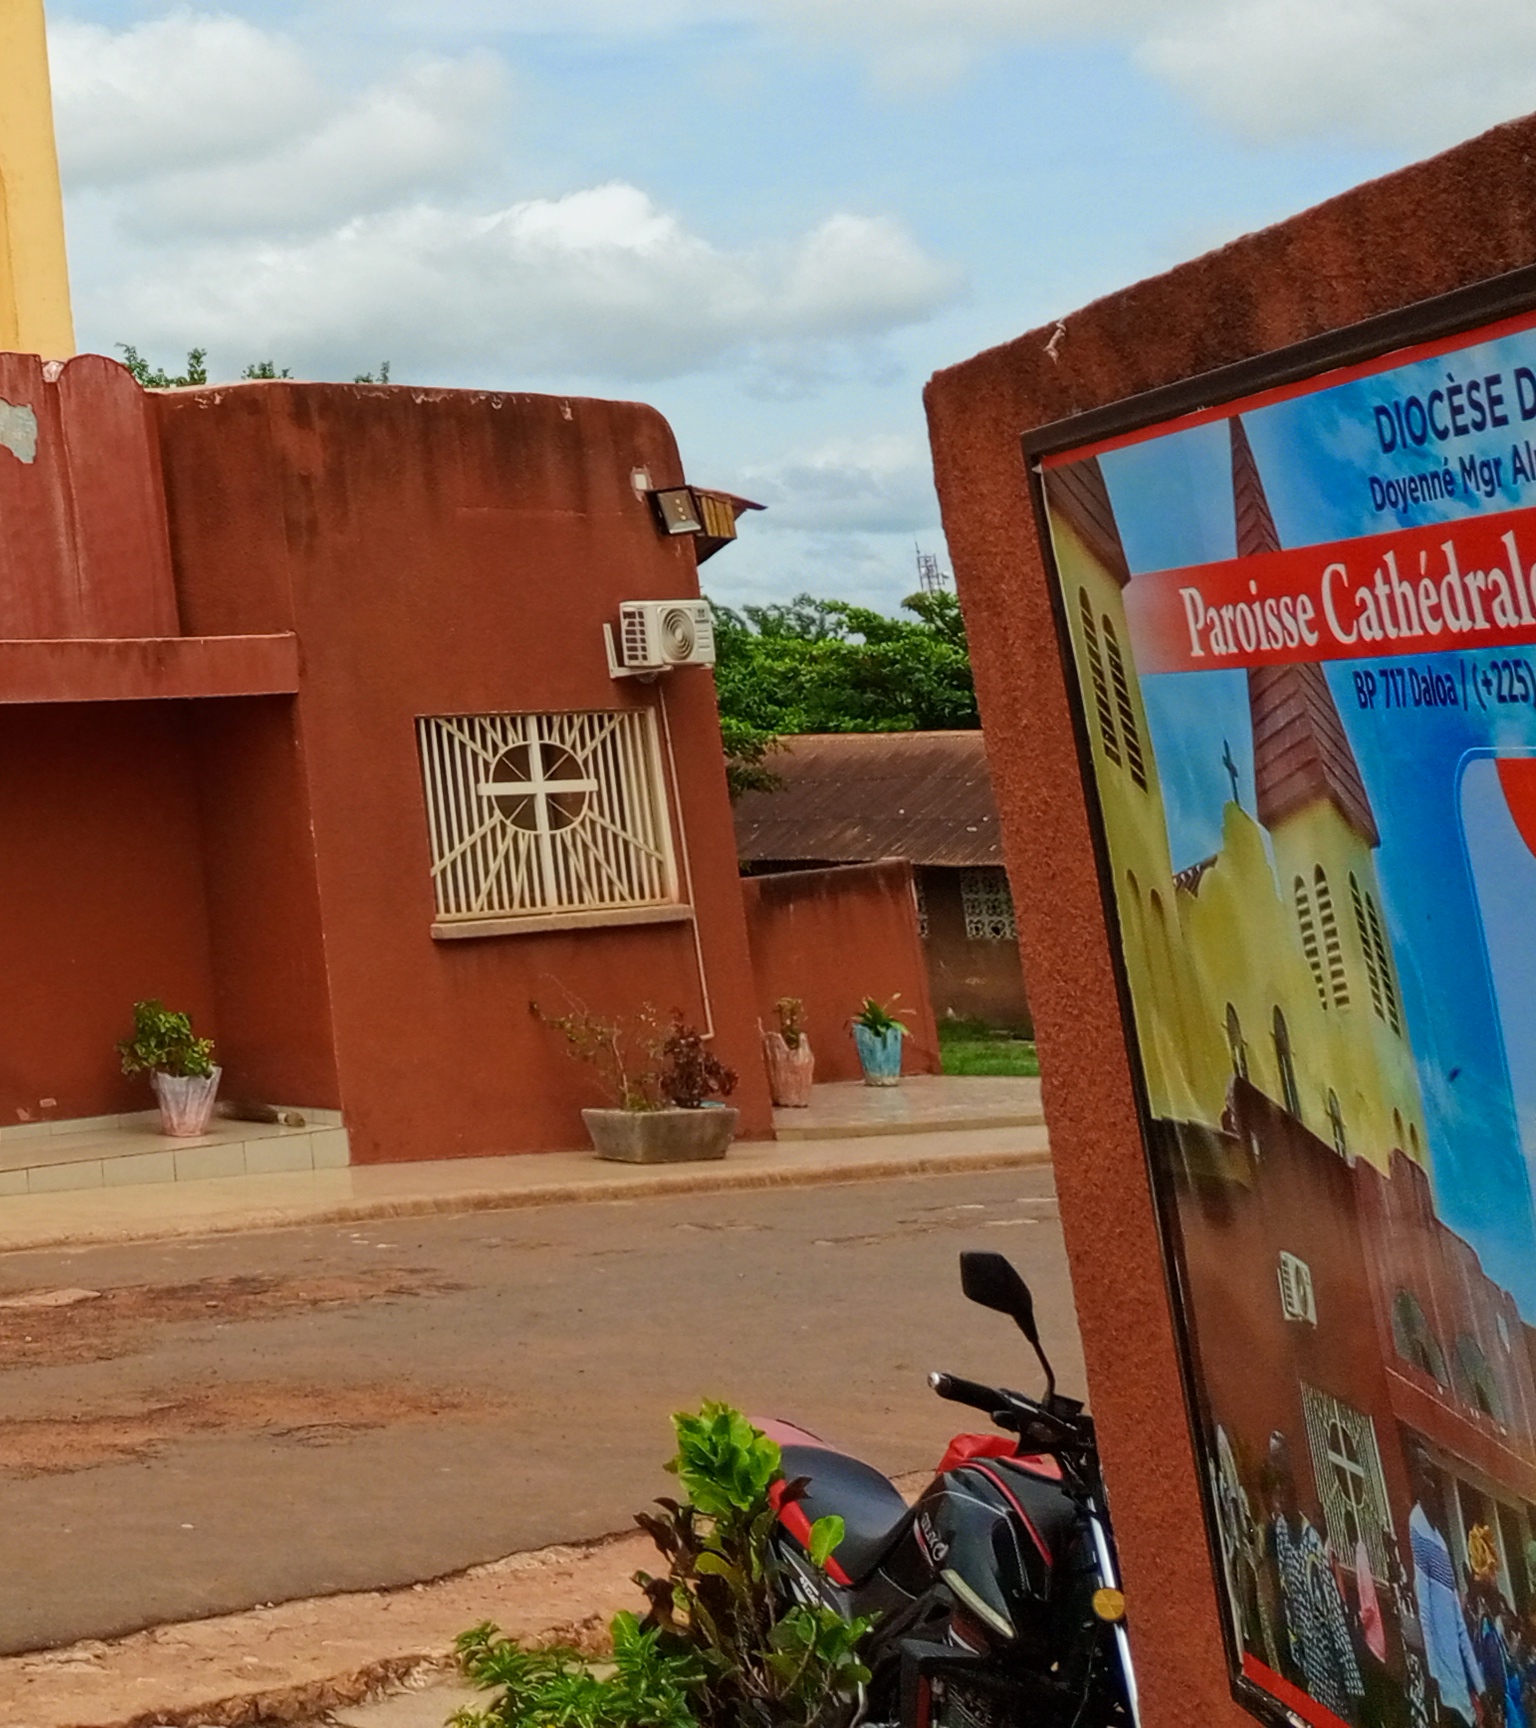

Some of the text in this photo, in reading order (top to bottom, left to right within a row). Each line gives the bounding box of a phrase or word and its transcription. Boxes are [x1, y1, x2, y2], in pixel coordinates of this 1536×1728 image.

[1373, 372, 1509, 454] DIOCÈSE
[1368, 440, 1536, 514] Doyenné Mgr Al
[1179, 578, 1319, 657] Paroisse
[1352, 669, 1376, 709] BP
[1378, 667, 1406, 709] 717
[1406, 663, 1459, 708] Daloa
[1471, 658, 1536, 712] (+225)
